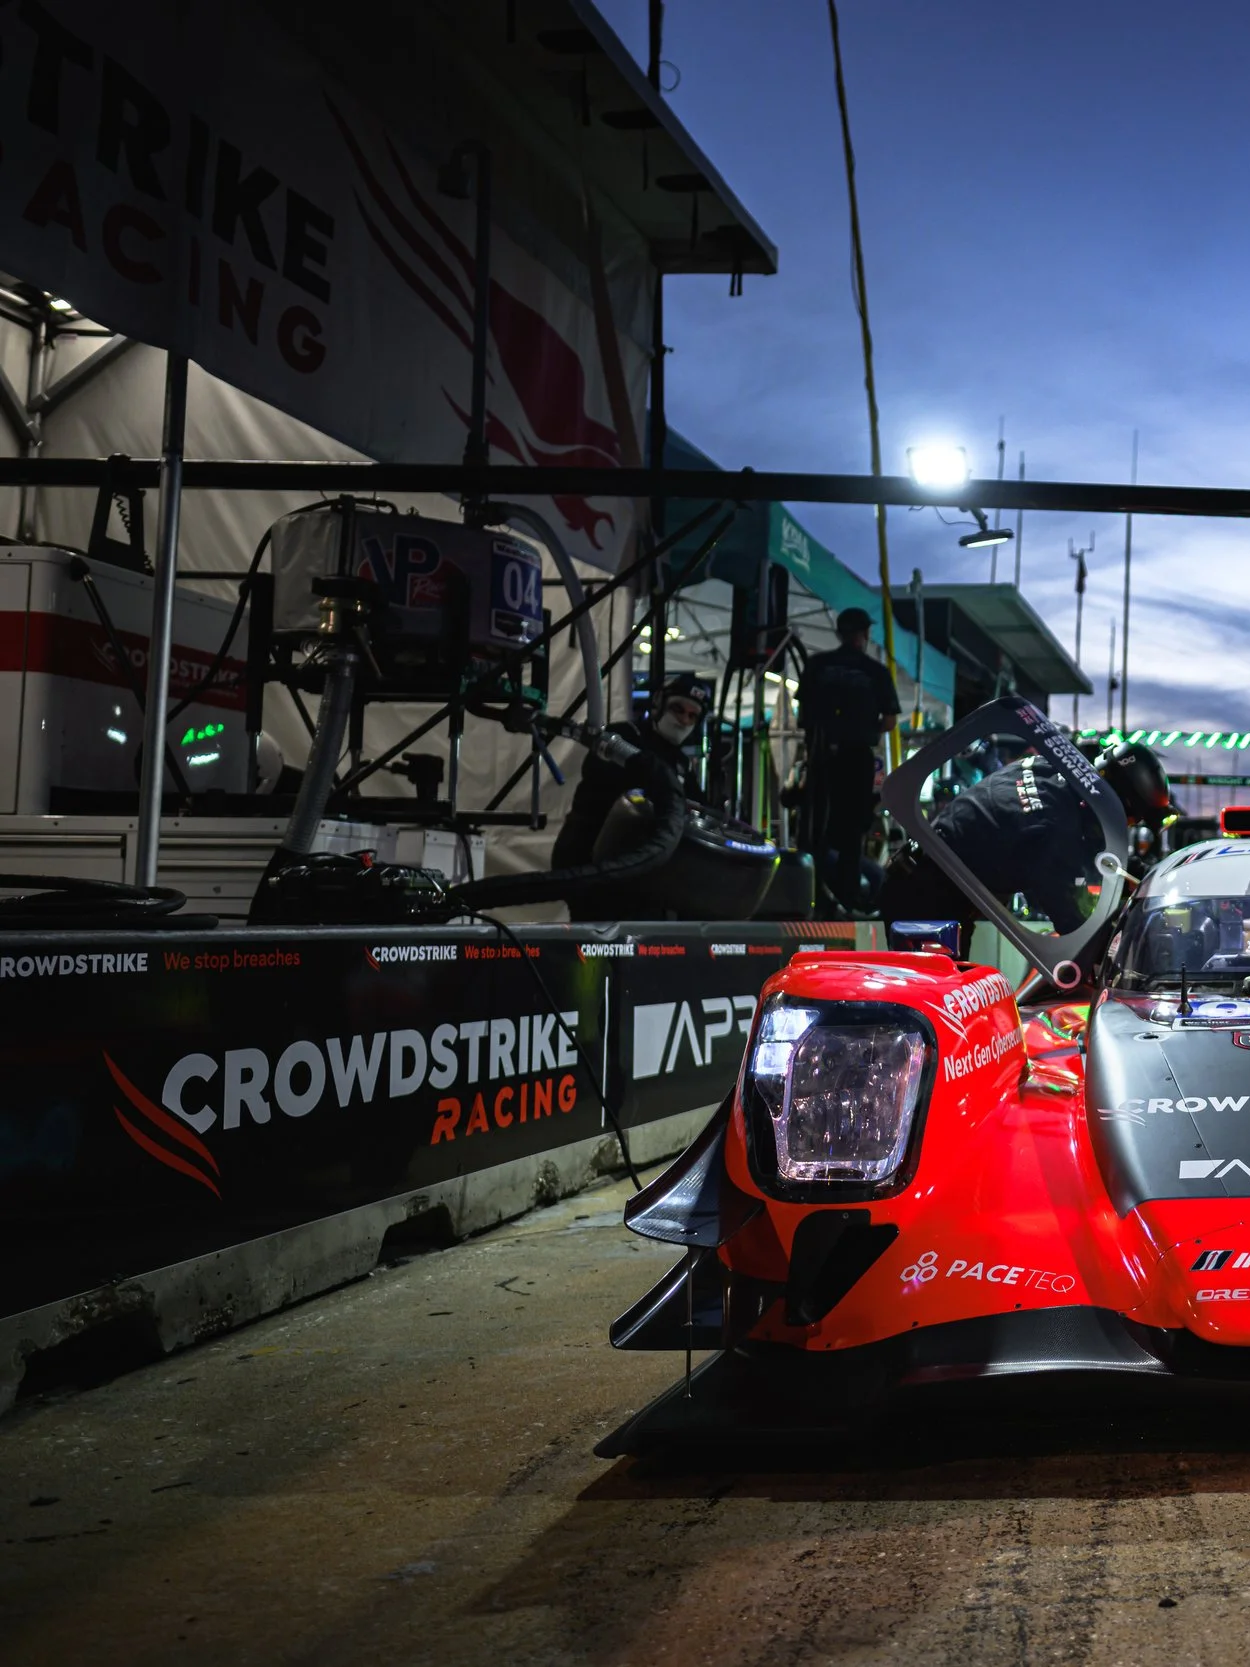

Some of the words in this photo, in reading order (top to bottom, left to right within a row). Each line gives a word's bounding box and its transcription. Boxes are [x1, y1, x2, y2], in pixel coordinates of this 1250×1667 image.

[0, 0, 335, 304] TRIKE
[0, 142, 327, 374] ACING
[361, 532, 443, 608] VP
[502, 560, 538, 614] 04
[1044, 738, 1100, 795] SOWERY
[0, 953, 148, 977] ROWDSTRIKE
[163, 951, 190, 970] We
[194, 953, 230, 972] stop
[232, 948, 302, 968] breaches
[372, 945, 457, 962] CROWDSTRIKE
[464, 945, 479, 959] We
[581, 943, 634, 957] CROWDSTRIKE
[161, 1010, 580, 1135] CROWDSTRIKE
[943, 1052, 974, 1082] Next
[974, 1043, 992, 1069] Gen
[430, 1074, 578, 1145] RACING
[945, 1259, 1076, 1293] PACETEQ
